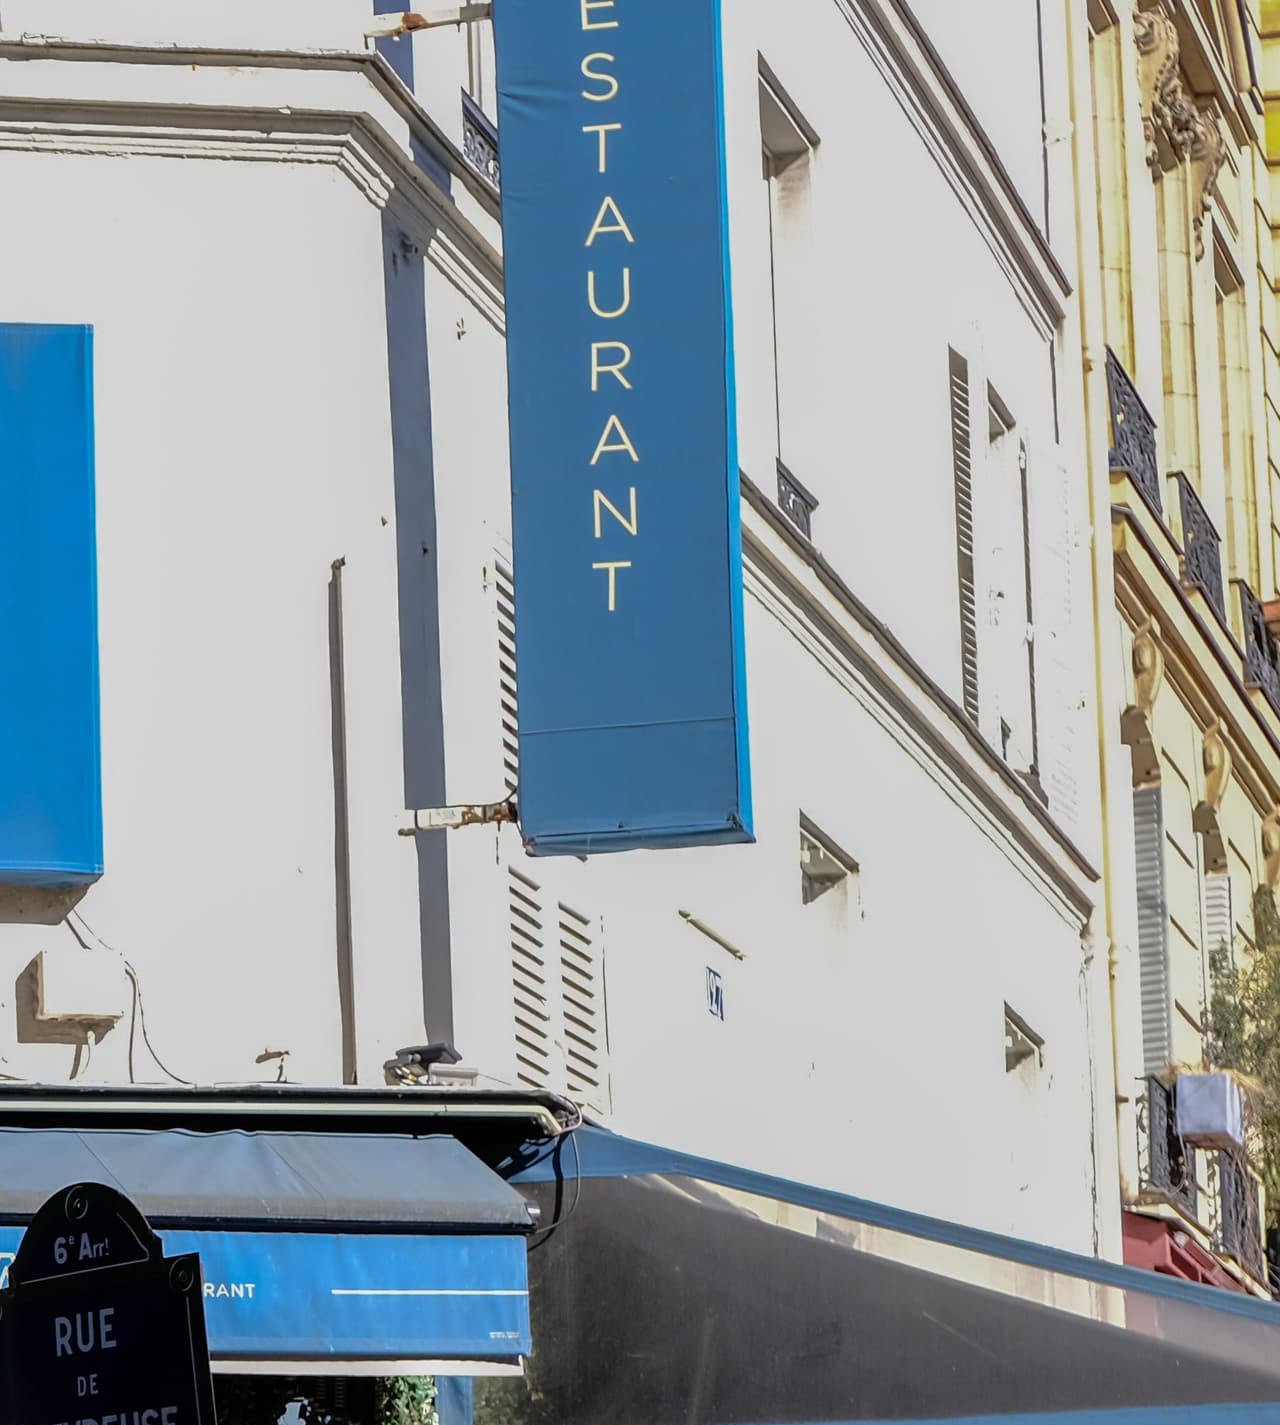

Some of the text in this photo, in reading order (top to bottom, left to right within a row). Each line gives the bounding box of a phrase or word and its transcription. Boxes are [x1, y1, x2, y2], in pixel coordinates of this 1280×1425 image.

[579, 0, 641, 613] ESTAURANT
[54, 1306, 119, 1359] RUE
[76, 1372, 100, 1398] DE
